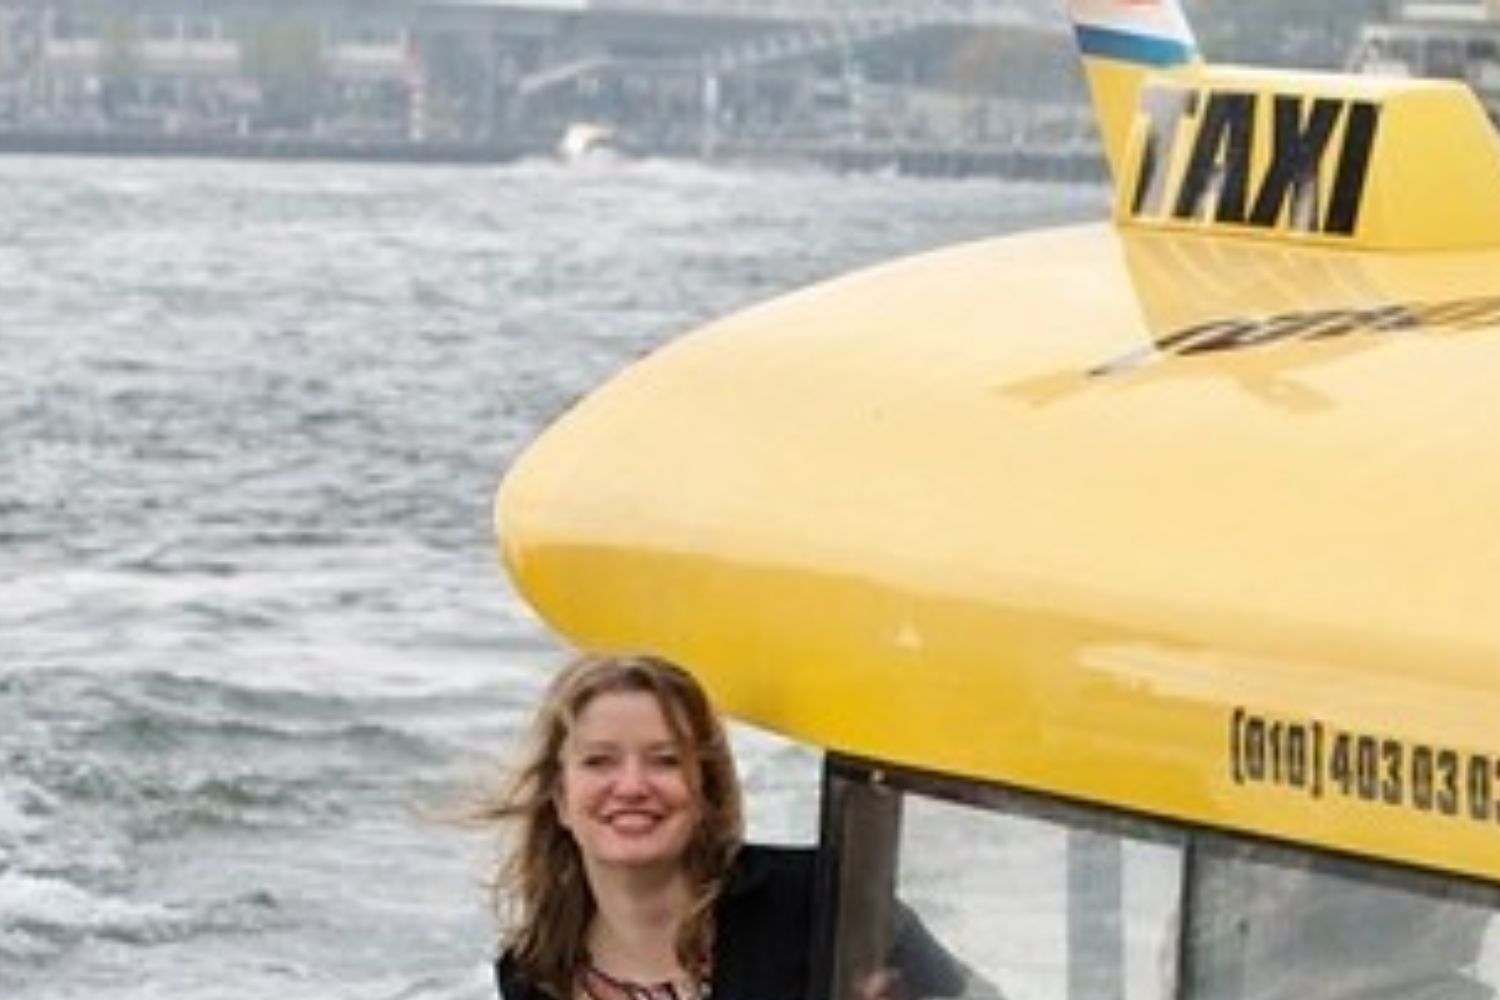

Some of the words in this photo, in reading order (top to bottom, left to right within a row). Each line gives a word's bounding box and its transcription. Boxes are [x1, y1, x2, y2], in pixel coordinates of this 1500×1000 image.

[1132, 84, 1384, 236] TAXI
[1330, 731, 1403, 805] 403
[1411, 744, 1458, 815] 03
